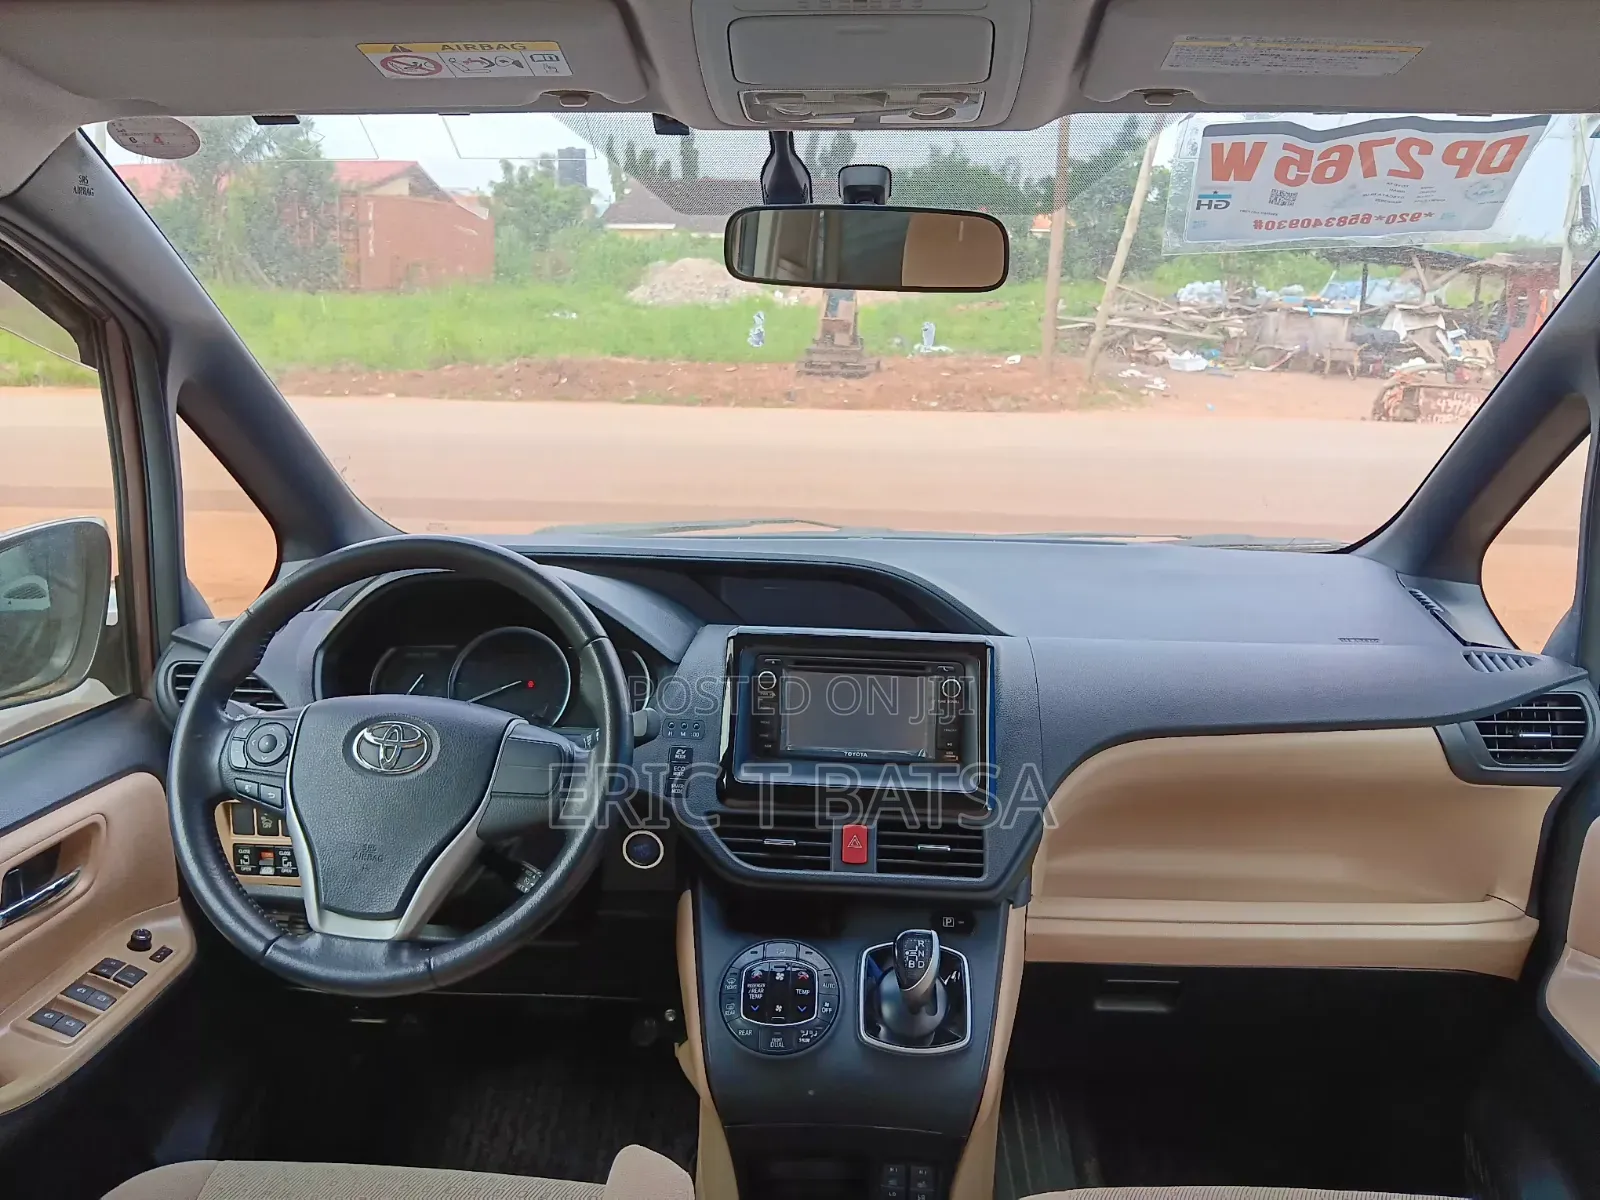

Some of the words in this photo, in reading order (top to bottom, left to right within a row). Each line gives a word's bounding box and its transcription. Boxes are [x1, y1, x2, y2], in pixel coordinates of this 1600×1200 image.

[441, 43, 527, 51] AIRBAG
[73, 185, 95, 197] AIRBAG
[908, 960, 915, 968] B
